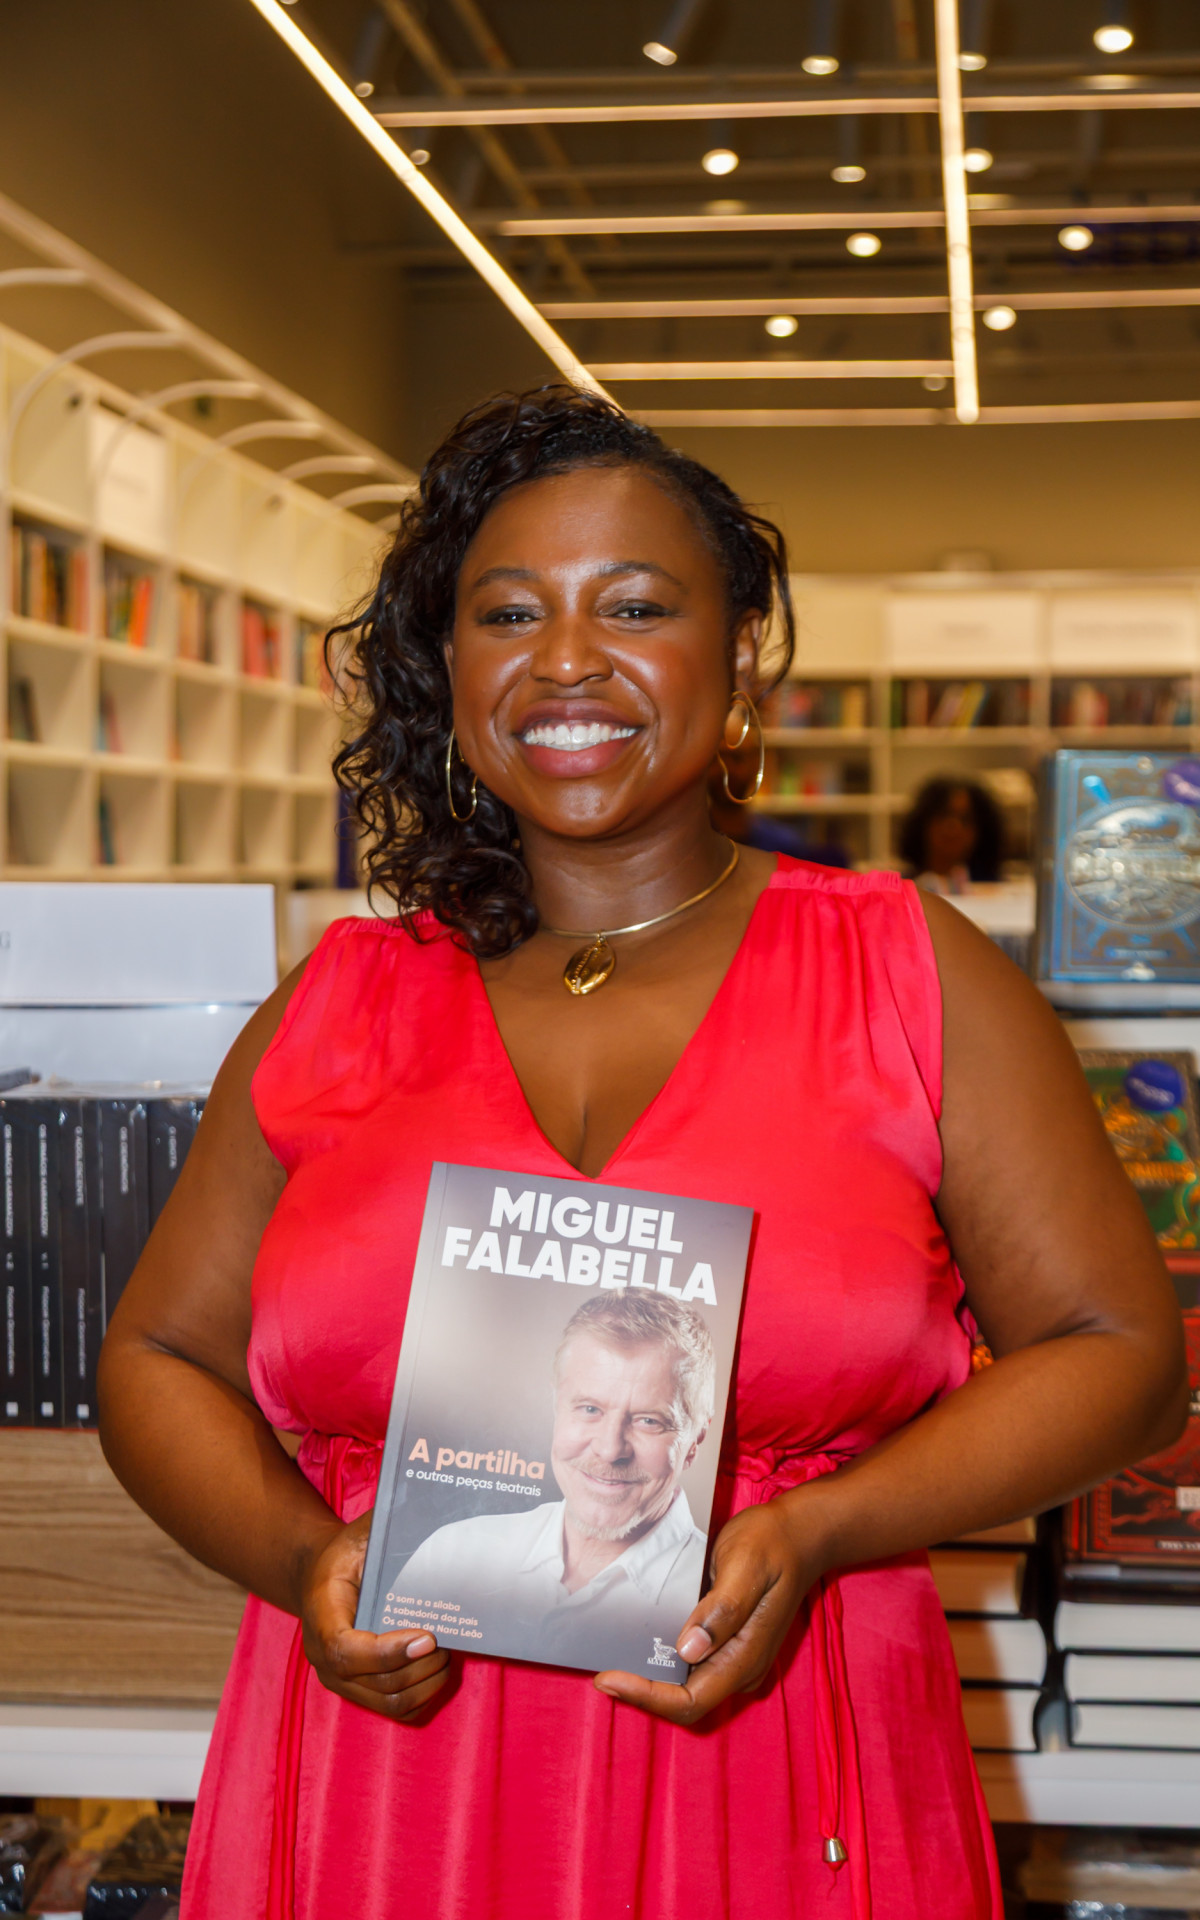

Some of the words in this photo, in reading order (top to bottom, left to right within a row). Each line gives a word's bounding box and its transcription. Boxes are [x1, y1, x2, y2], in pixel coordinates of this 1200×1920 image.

[489, 1186, 684, 1254] MIGUEL
[441, 1226, 718, 1306] FALABELLA
[408, 1437, 430, 1463] A
[435, 1447, 546, 1480] partilha
[405, 1469, 414, 1478] e
[416, 1470, 454, 1484] outras
[456, 1476, 493, 1490] peças
[496, 1480, 542, 1497] teatrais
[386, 1592, 395, 1601] O
[396, 1596, 415, 1604] som
[416, 1598, 423, 1606] e
[384, 1604, 391, 1613] A
[393, 1606, 439, 1620] sabedoria
[440, 1613, 457, 1623] dos
[382, 1616, 395, 1625] Os
[397, 1618, 421, 1629] olhos
[422, 1622, 435, 1632] de
[436, 1624, 459, 1635] Nara
[460, 1628, 483, 1639] Leão
[646, 1657, 676, 1668] MATRIX
